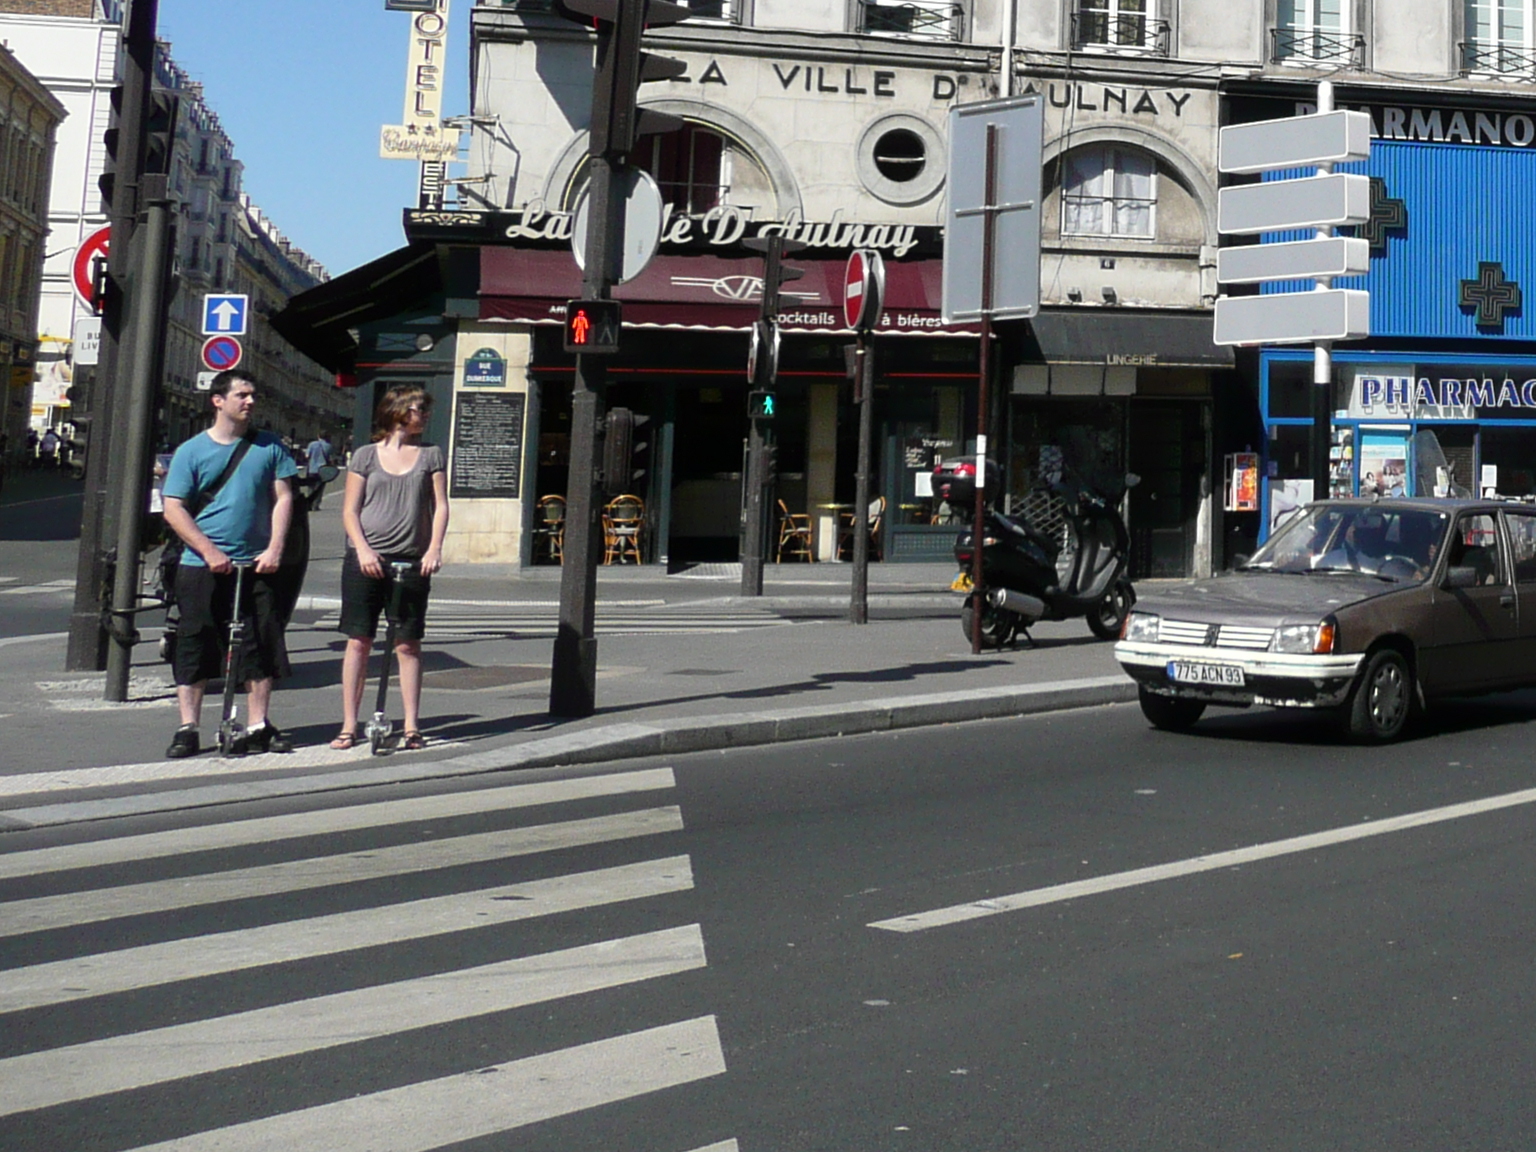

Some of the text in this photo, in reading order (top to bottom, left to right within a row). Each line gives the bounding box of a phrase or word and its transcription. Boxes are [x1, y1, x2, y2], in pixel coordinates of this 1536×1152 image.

[772, 63, 896, 98] VILLE
[505, 198, 574, 240] La
[897, 313, 942, 327] bières
[1106, 353, 1158, 366] LINGERIE
[1175, 662, 1242, 684] 775 ACN 93
